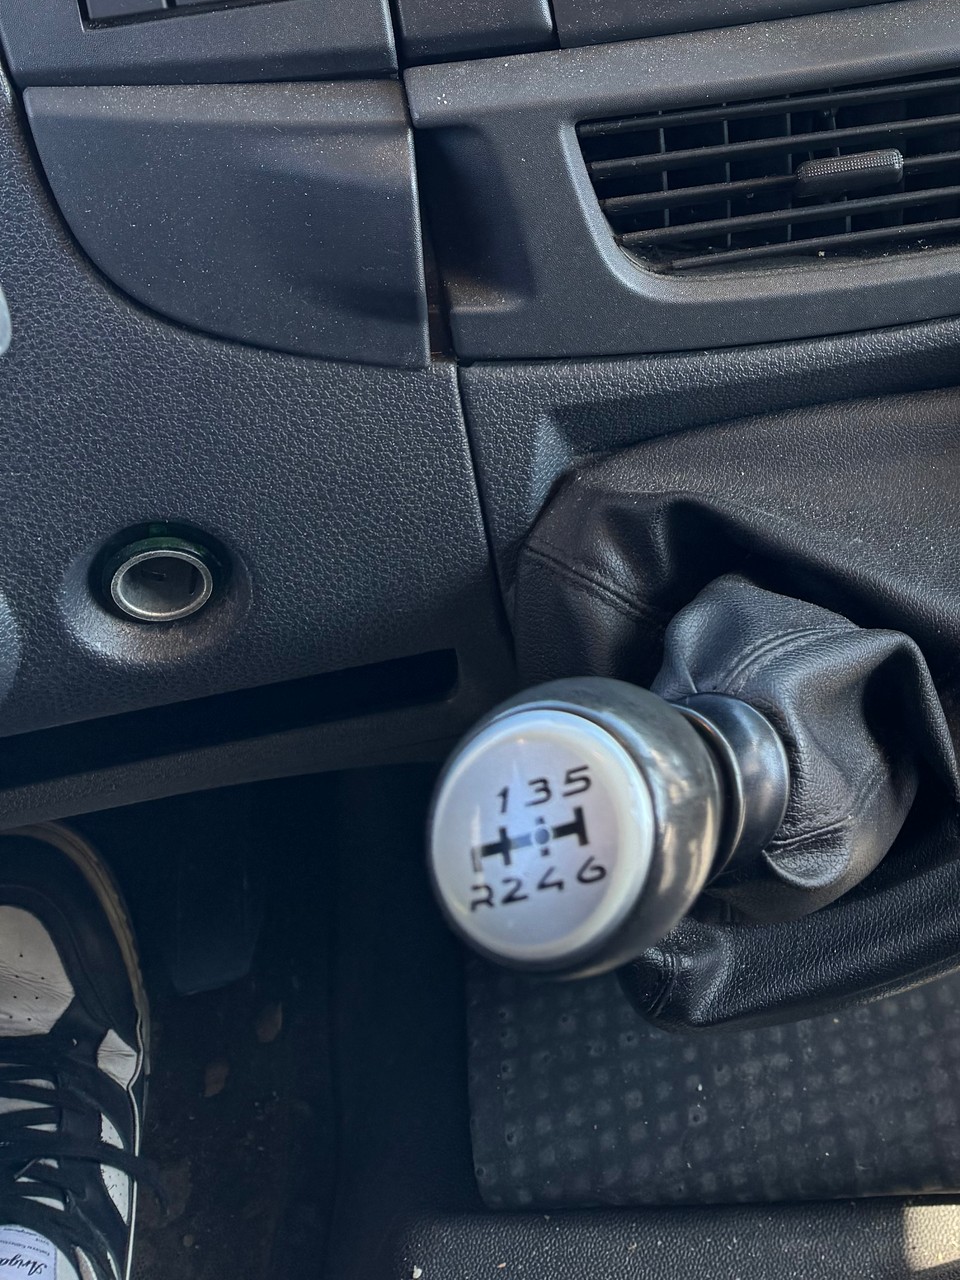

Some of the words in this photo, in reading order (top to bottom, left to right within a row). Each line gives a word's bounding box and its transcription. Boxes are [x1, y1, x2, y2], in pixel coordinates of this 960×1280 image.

[496, 785, 510, 814] 1
[525, 778, 552, 807] 3
[562, 765, 592, 797] 5
[501, 877, 529, 904] 2
[537, 866, 565, 893] 4
[576, 855, 607, 884] 6
